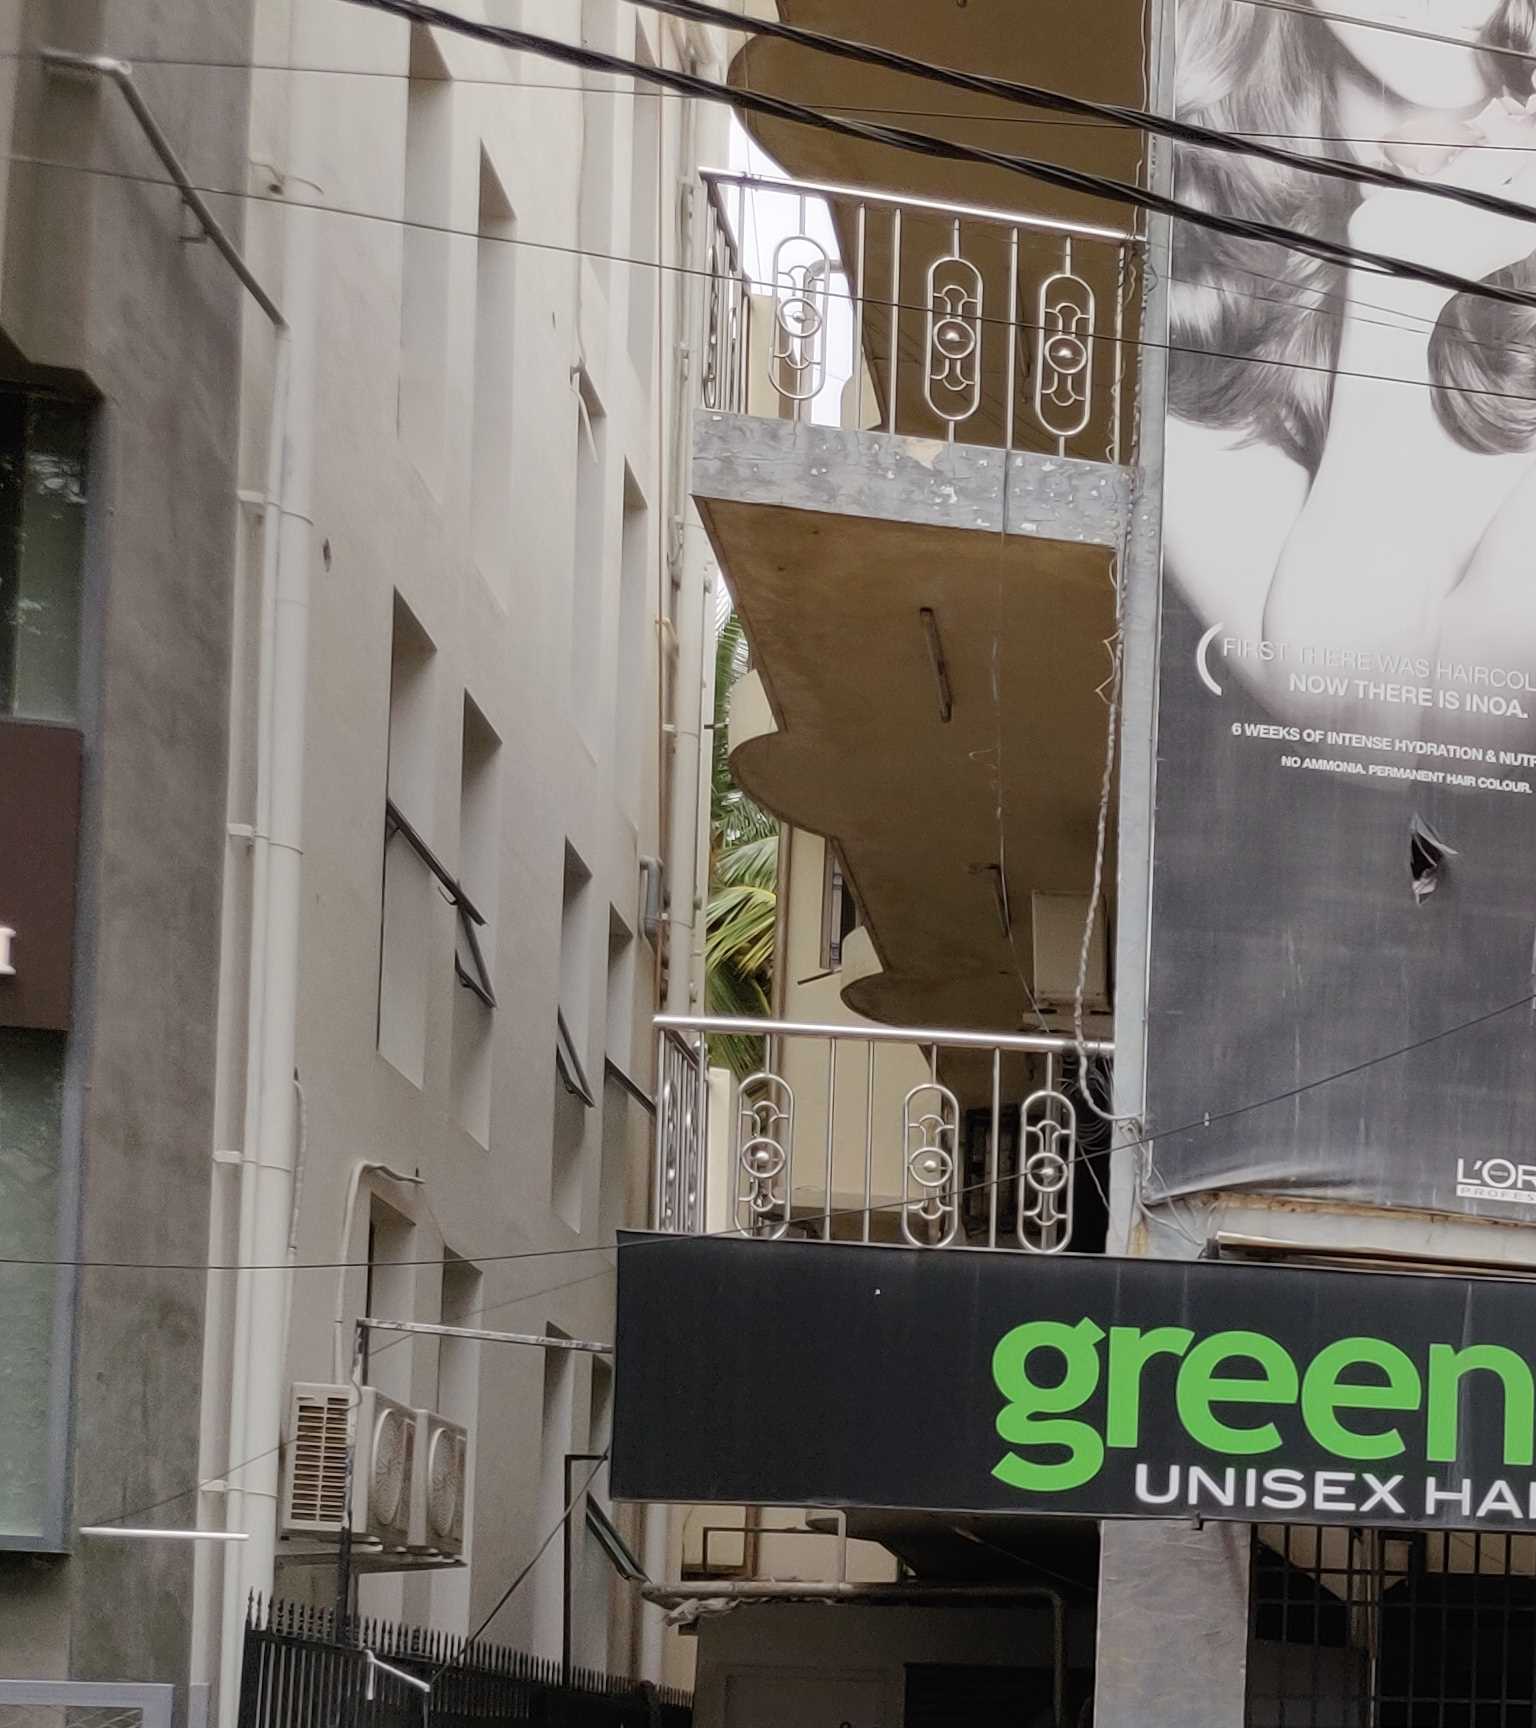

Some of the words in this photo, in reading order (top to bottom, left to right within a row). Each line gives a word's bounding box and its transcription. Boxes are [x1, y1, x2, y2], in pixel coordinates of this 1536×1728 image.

[1223, 638, 1288, 662] FIRST
[1298, 647, 1370, 671] THERE
[1376, 653, 1430, 678] WAS
[1290, 674, 1348, 696] NOW
[1354, 679, 1433, 706] THERE
[1439, 689, 1460, 709] IS
[1465, 692, 1529, 719] INOA.
[1231, 723, 1242, 736] 6
[1243, 724, 1300, 742] WEEKS
[1303, 729, 1325, 744] OF
[1327, 731, 1392, 751] INTENSE
[1394, 738, 1483, 762] HYDRATION
[1485, 750, 1497, 764] &
[1280, 755, 1301, 768] NO
[1368, 764, 1446, 783] PERMANENT
[1446, 773, 1476, 788] HAIR
[1478, 776, 1532, 794] COLOUR.
[991, 1315, 1535, 1494] green
[1133, 1462, 1405, 1516] UNISEX
